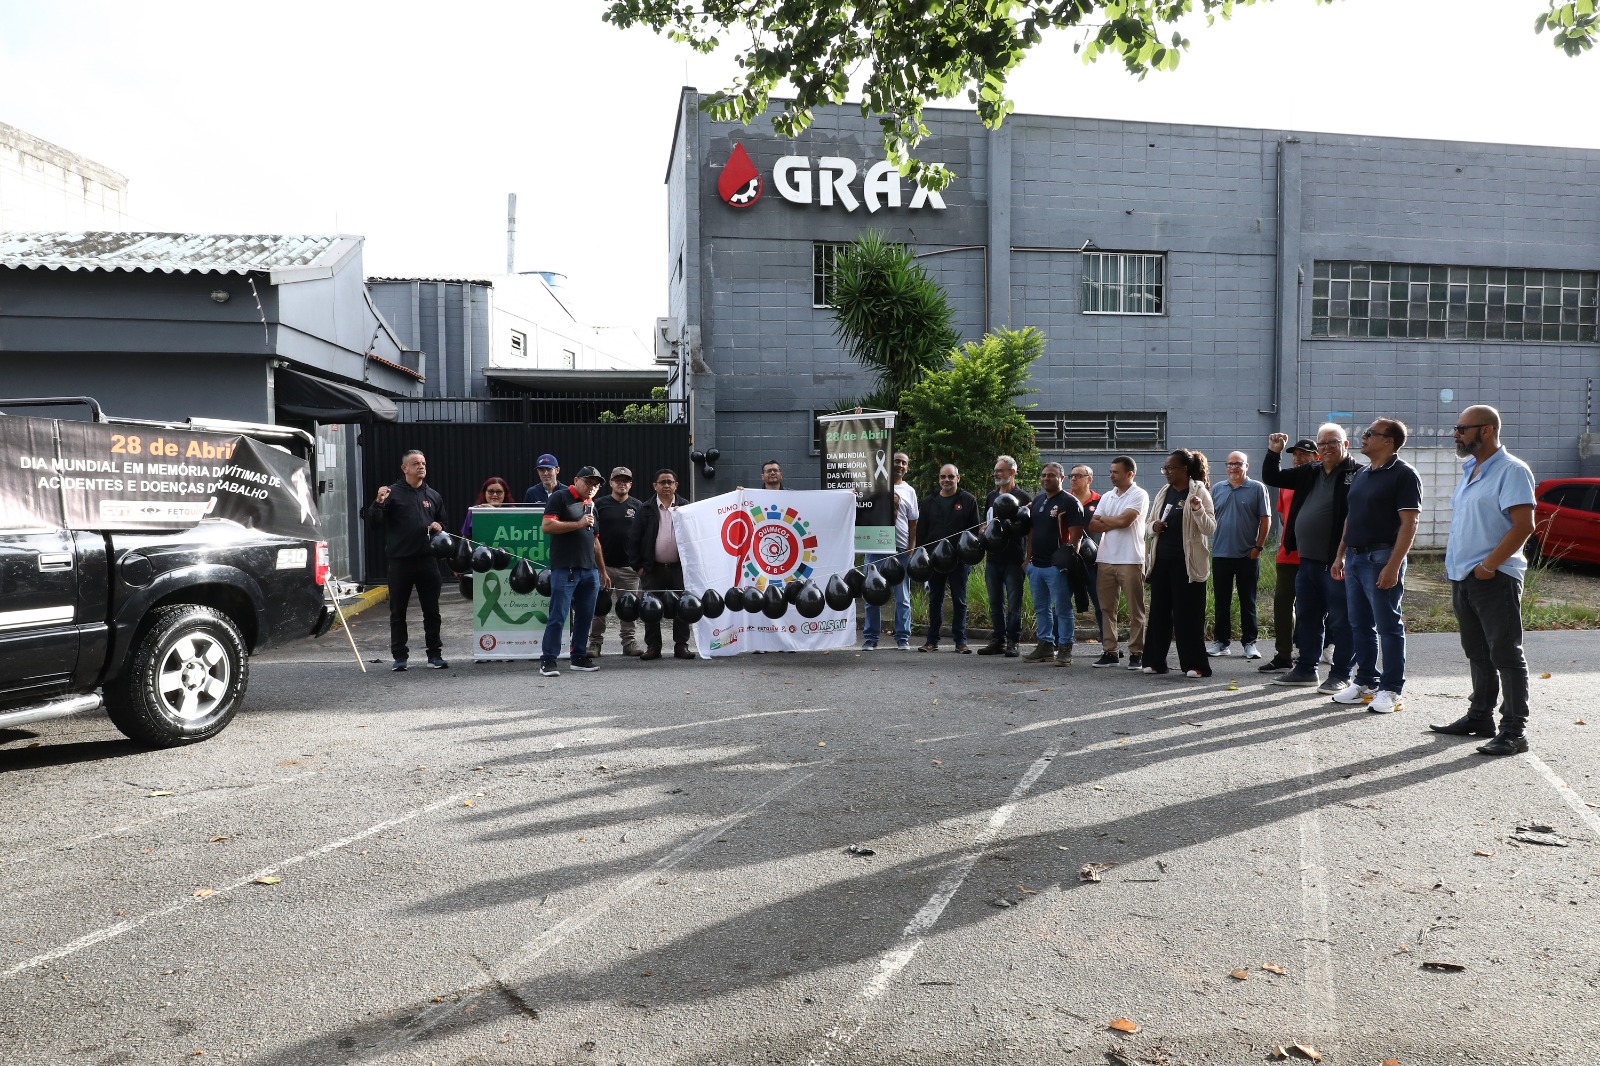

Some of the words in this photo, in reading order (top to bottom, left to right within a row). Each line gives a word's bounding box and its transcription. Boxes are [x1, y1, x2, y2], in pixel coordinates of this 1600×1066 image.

[773, 155, 948, 214] GRAX
[826, 431, 840, 442] 28
[843, 431, 857, 441] de
[861, 429, 888, 440] Abril
[110, 434, 142, 455] 28
[149, 438, 179, 457] de
[838, 451, 866, 459] MUNDIAL
[20, 456, 48, 470] DIA
[51, 458, 120, 473] MUNDIAL
[123, 462, 144, 474] EM
[147, 462, 210, 477] MEMÓRIA
[225, 464, 268, 484] VÍTIMAS
[268, 476, 281, 488] DE
[837, 461, 868, 469] MEMÓRIA
[840, 471, 867, 479] VÍTIMAS
[37, 476, 124, 491] ACIDENTES
[127, 480, 136, 492] E
[140, 481, 205, 495] DOENÇAS
[216, 480, 269, 500] RABALHO
[717, 503, 738, 515] RUMO
[493, 525, 544, 541] Abril
